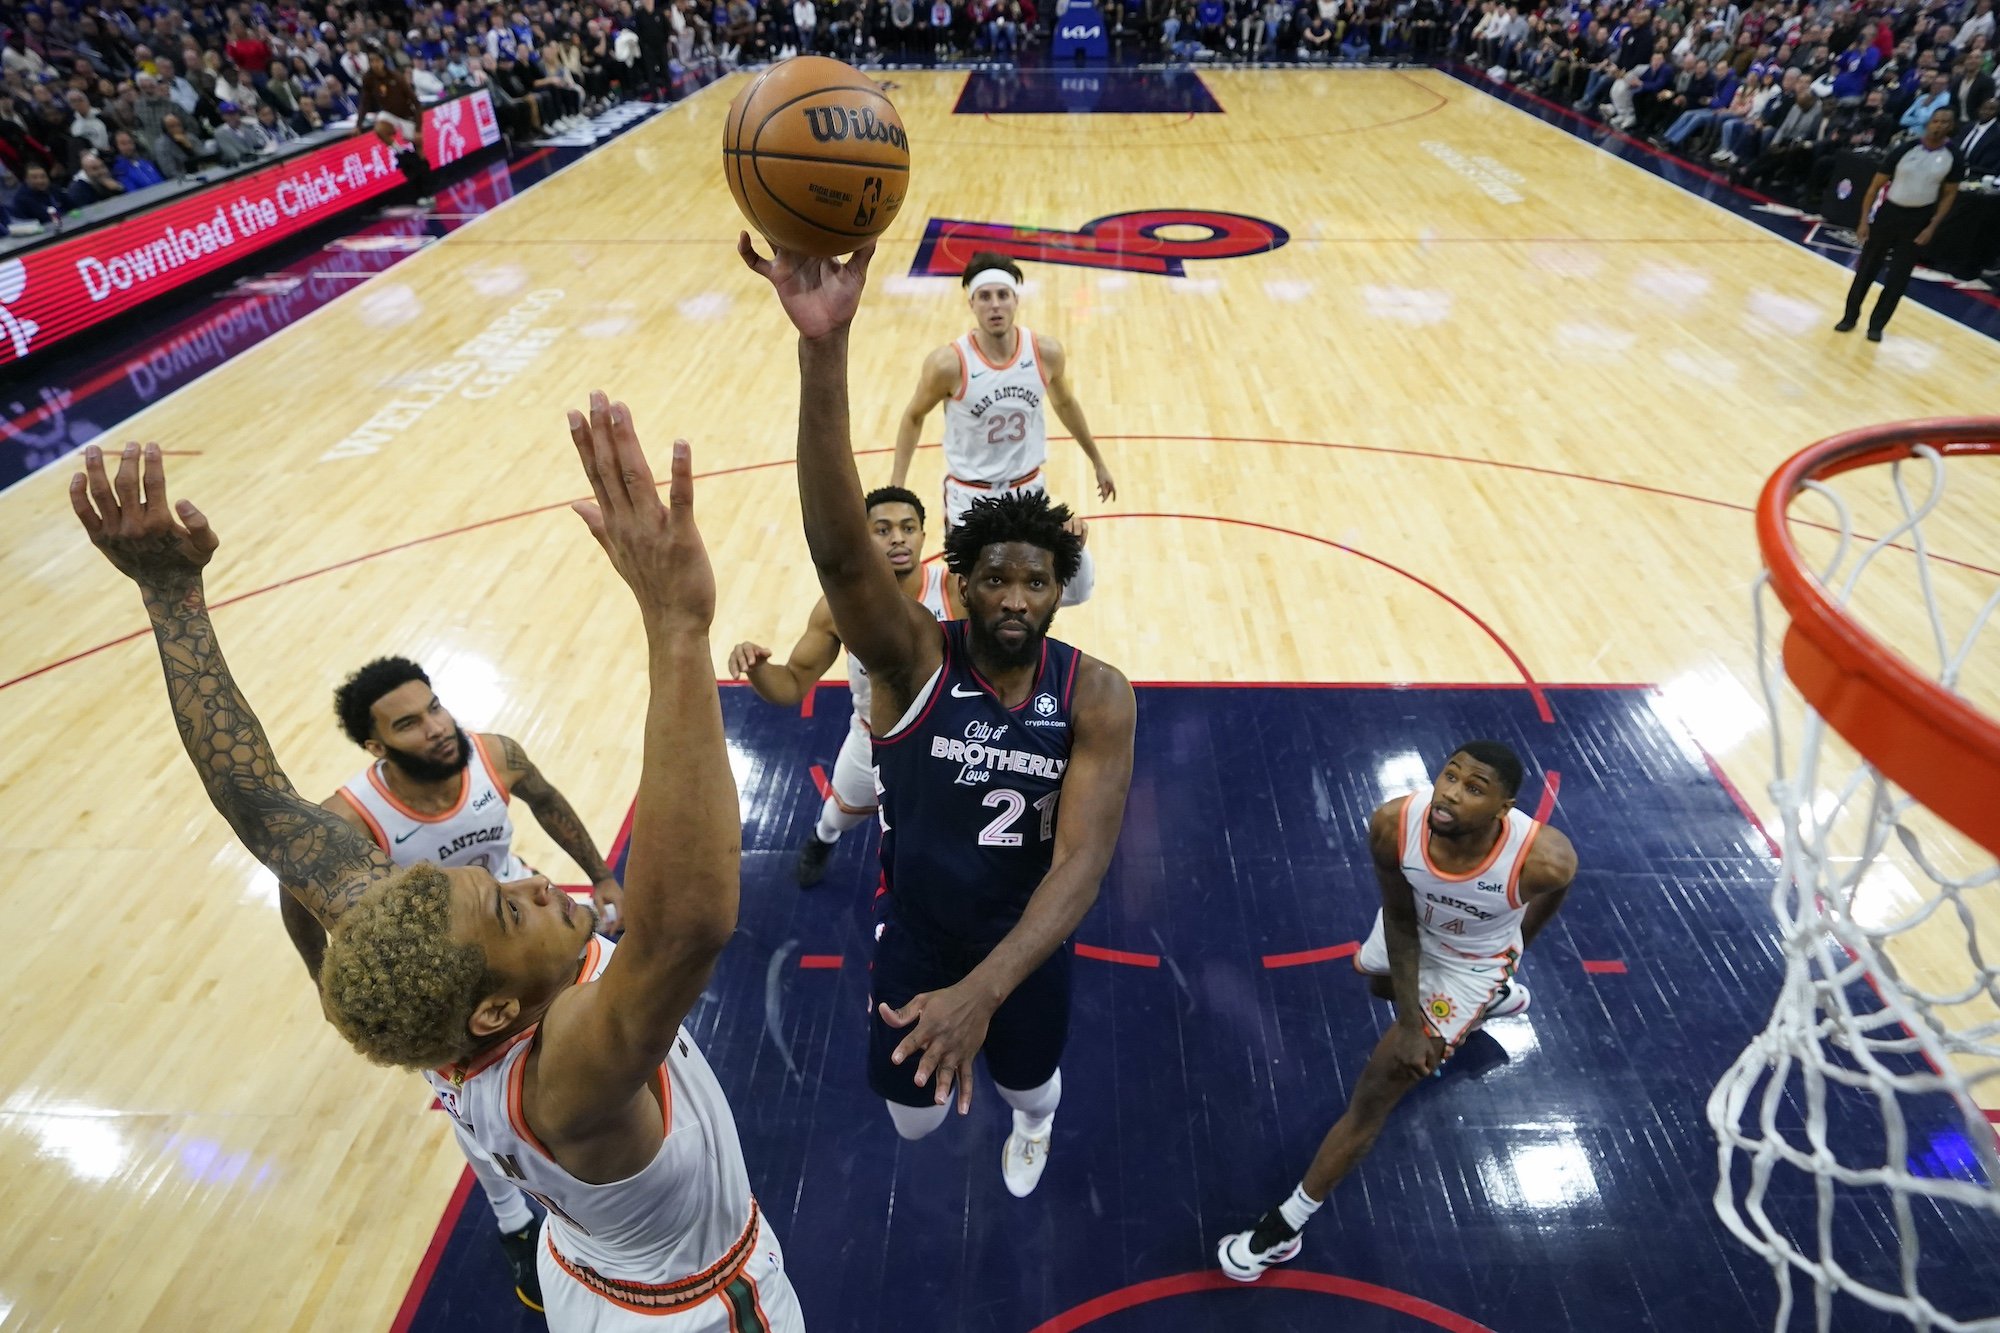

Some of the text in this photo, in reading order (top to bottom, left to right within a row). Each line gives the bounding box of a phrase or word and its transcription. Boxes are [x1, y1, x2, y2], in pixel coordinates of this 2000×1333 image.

[803, 105, 910, 156] Wilson
[76, 205, 236, 302] Download
[231, 195, 279, 238] the
[987, 411, 1026, 444] 23
[964, 720, 1008, 745] City of
[1025, 719, 1067, 728] crypto.com
[931, 735, 1068, 780] BROTHERLY
[954, 763, 990, 786] Love
[978, 788, 1061, 847] 21
[1477, 881, 1505, 894] Self.
